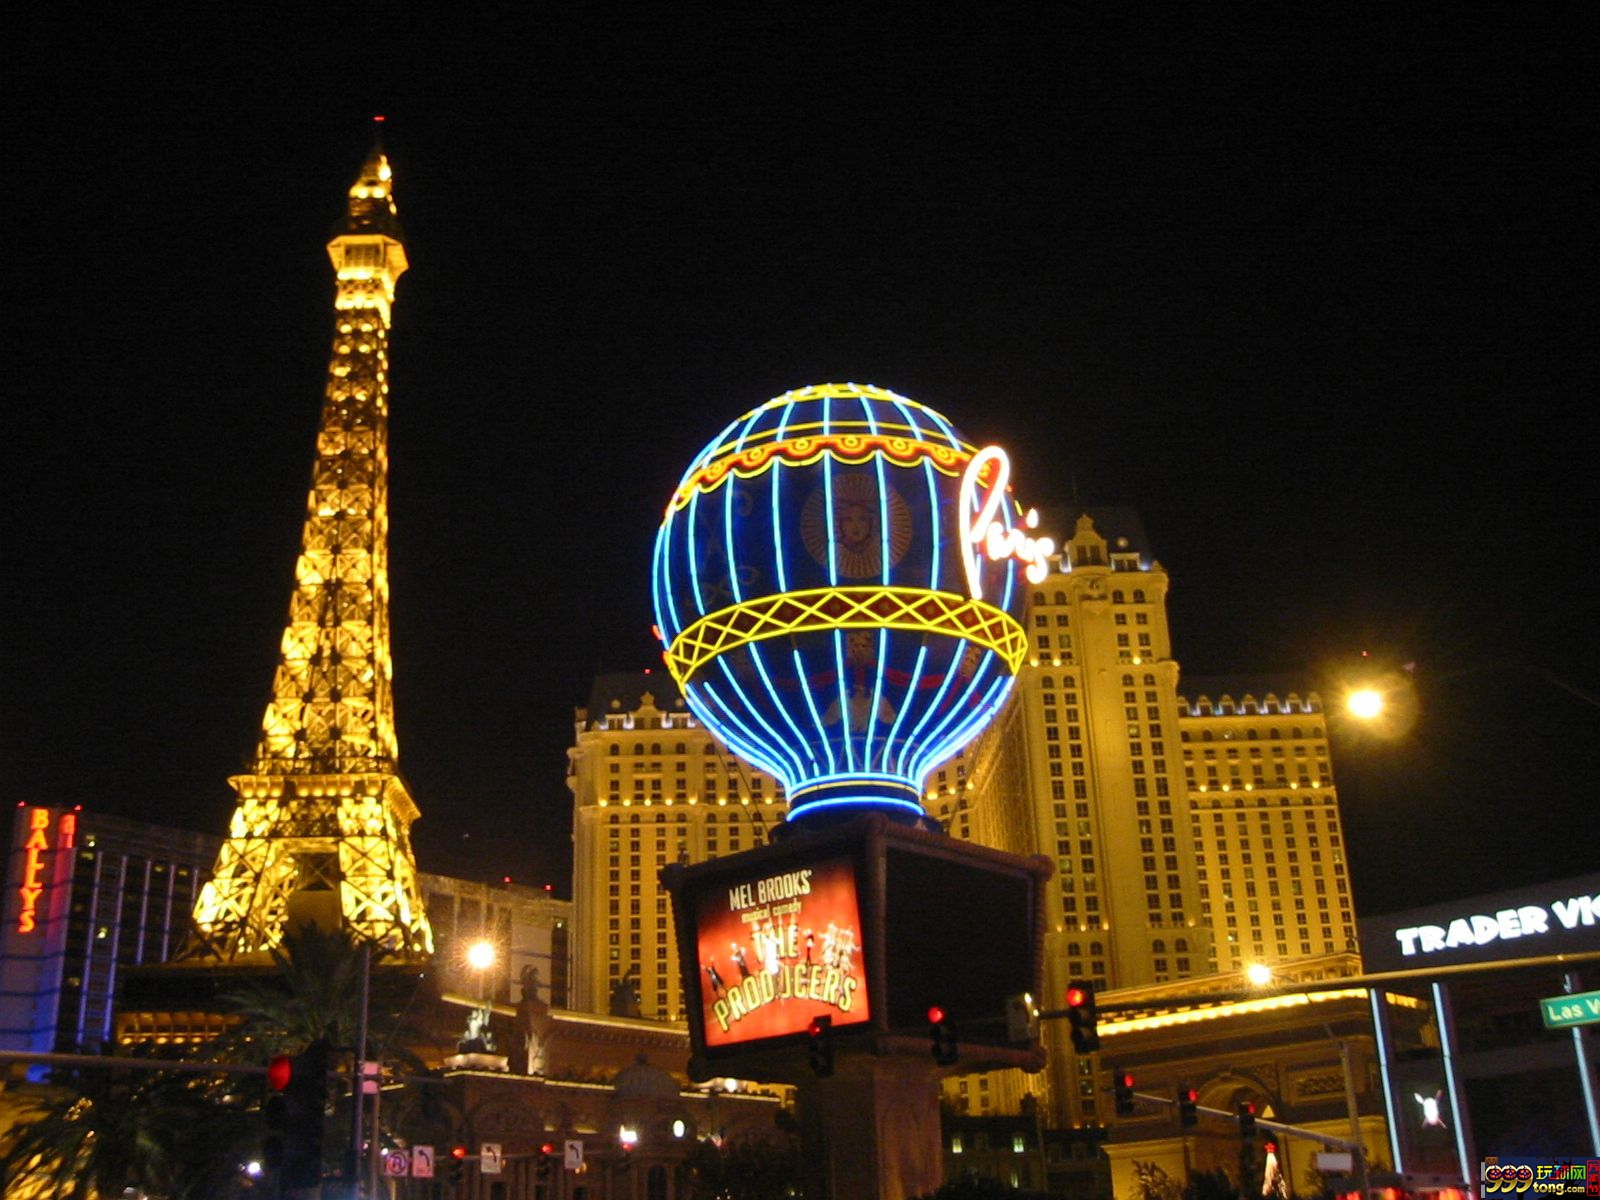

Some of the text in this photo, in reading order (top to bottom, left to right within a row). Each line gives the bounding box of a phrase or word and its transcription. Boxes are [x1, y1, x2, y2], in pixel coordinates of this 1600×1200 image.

[729, 883, 756, 911] MEL
[741, 897, 802, 924] musical comedy
[1396, 905, 1549, 956] TRADER
[1548, 1005, 1584, 1021] Las
